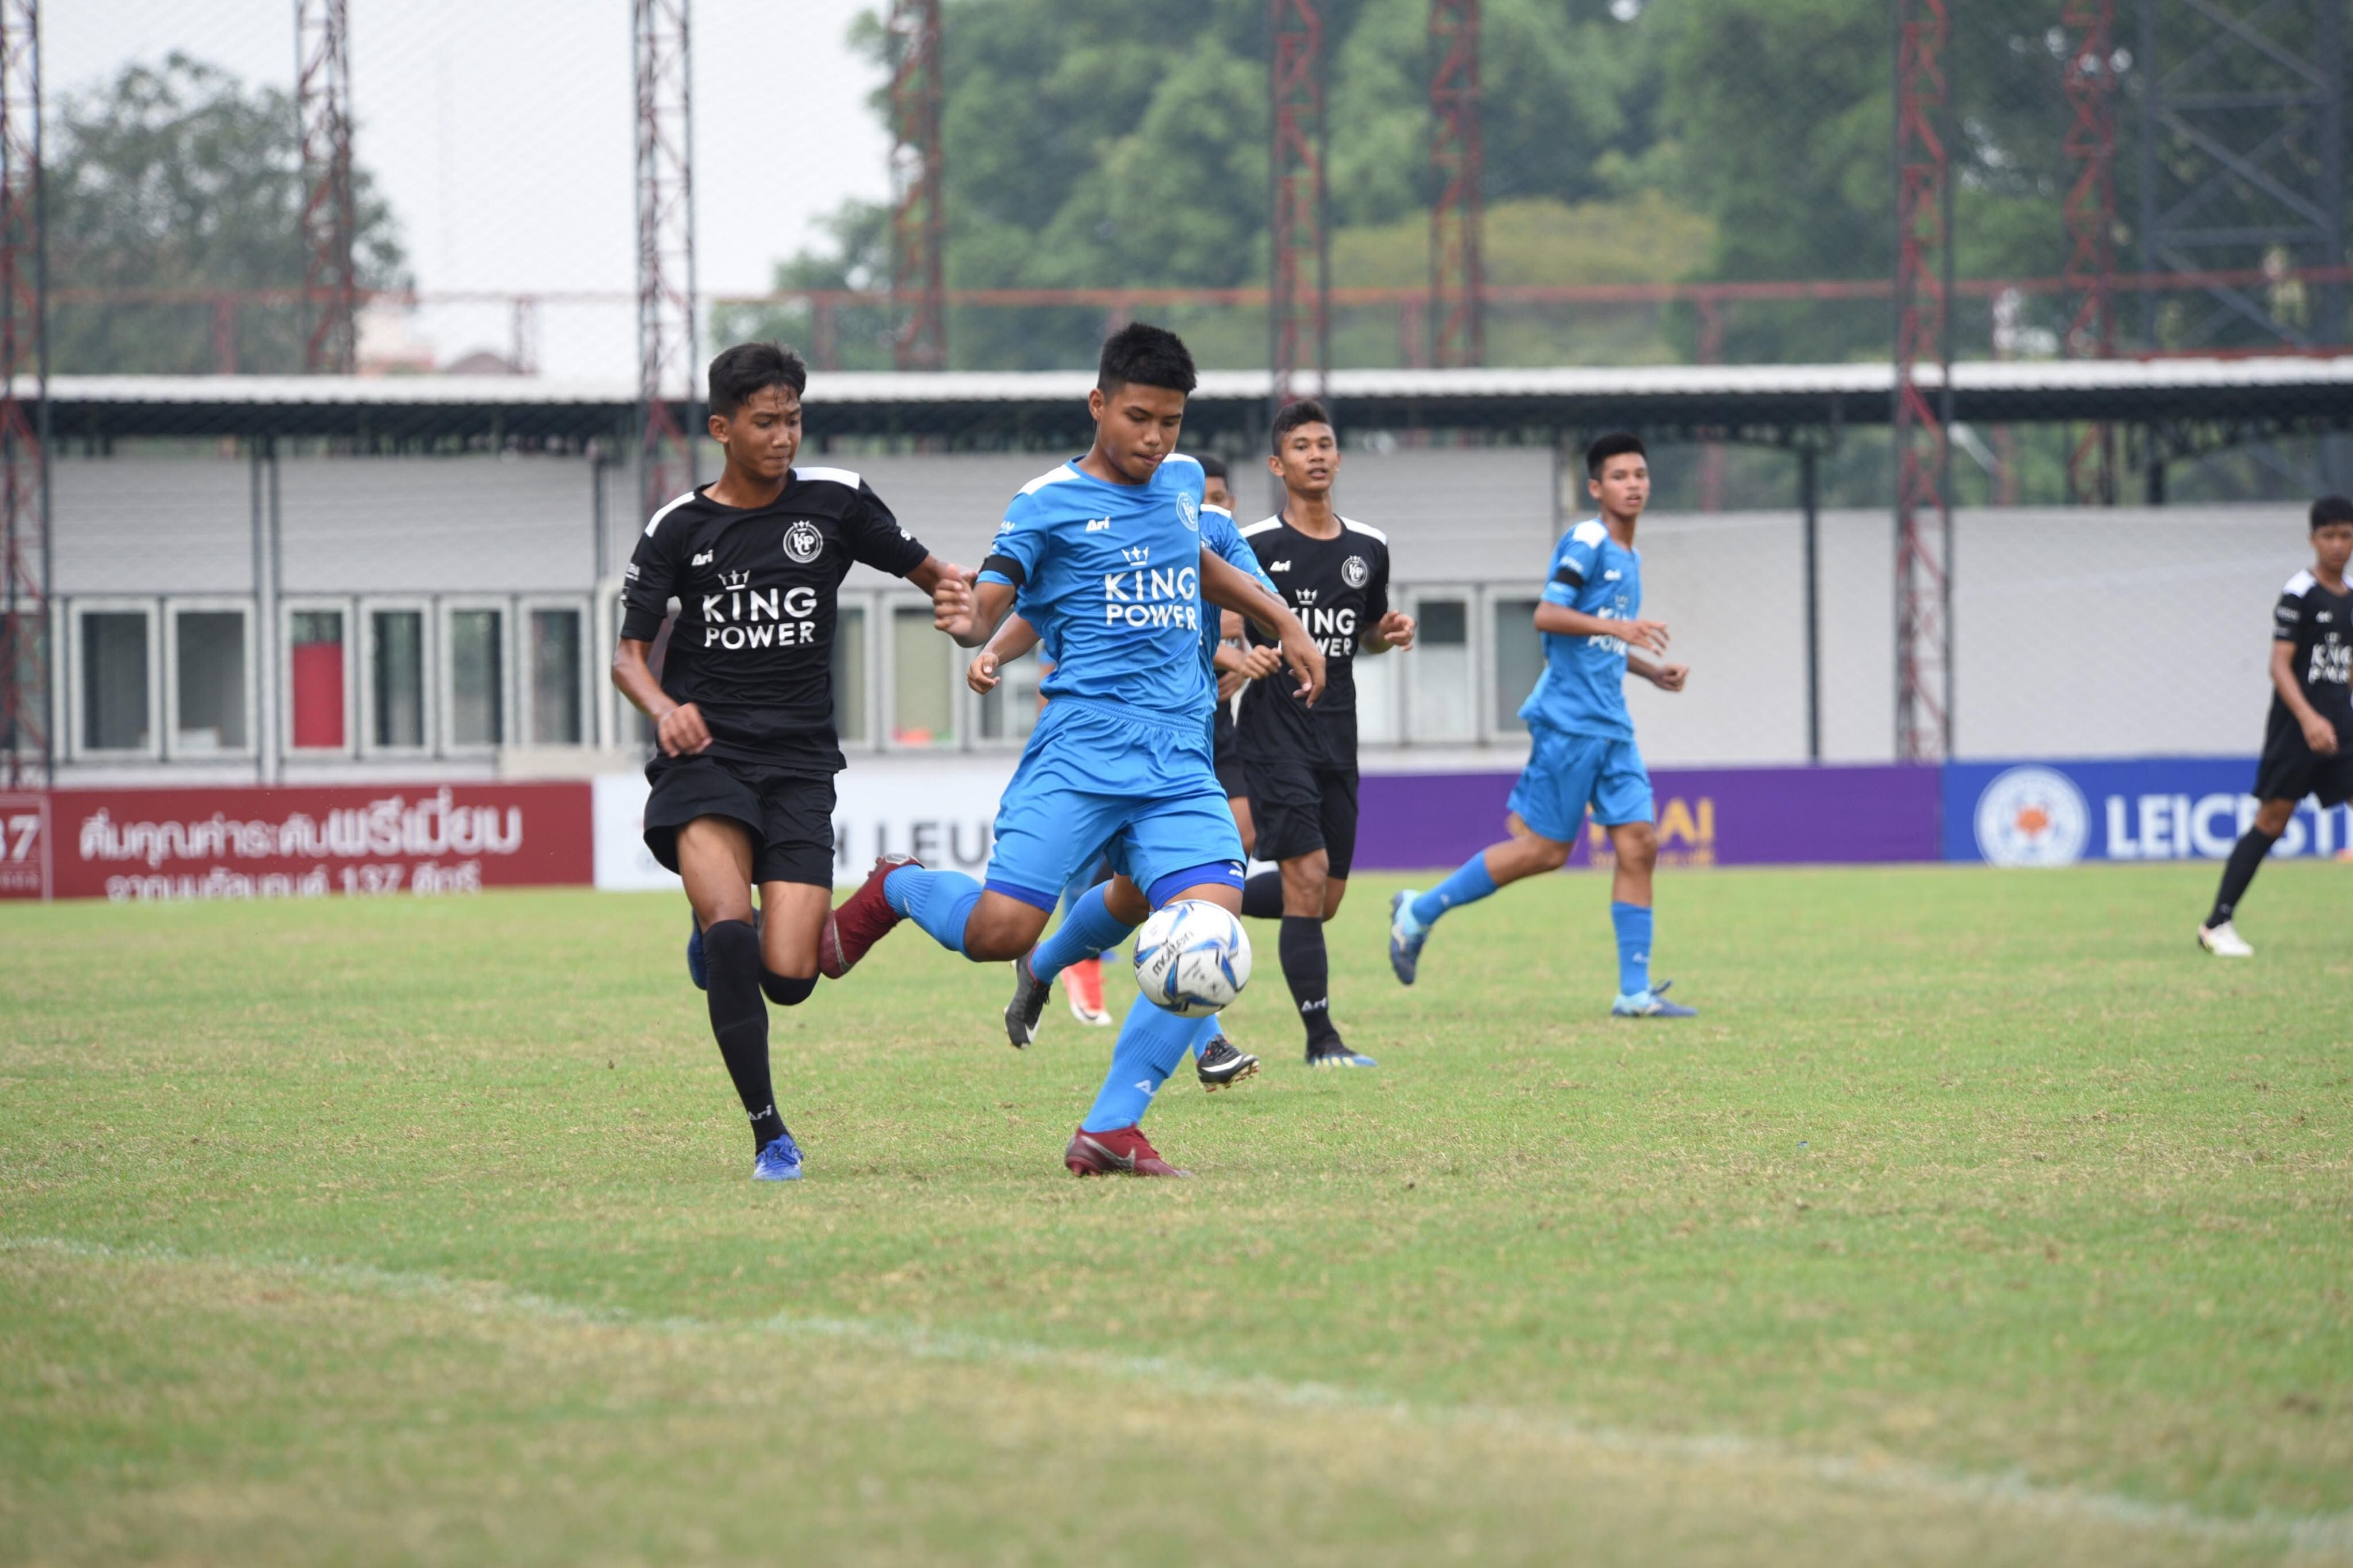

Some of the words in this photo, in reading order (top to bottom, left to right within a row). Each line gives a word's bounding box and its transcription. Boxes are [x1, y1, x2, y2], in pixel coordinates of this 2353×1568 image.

[1085, 516, 1110, 532] Ari
[691, 549, 713, 566] Ari
[1270, 560, 1291, 572] Ari
[1105, 566, 1196, 601] KING
[703, 586, 817, 623] KING
[1106, 603, 1197, 631] POWER
[704, 621, 815, 650] POWER
[748, 1104, 772, 1121] Ari
